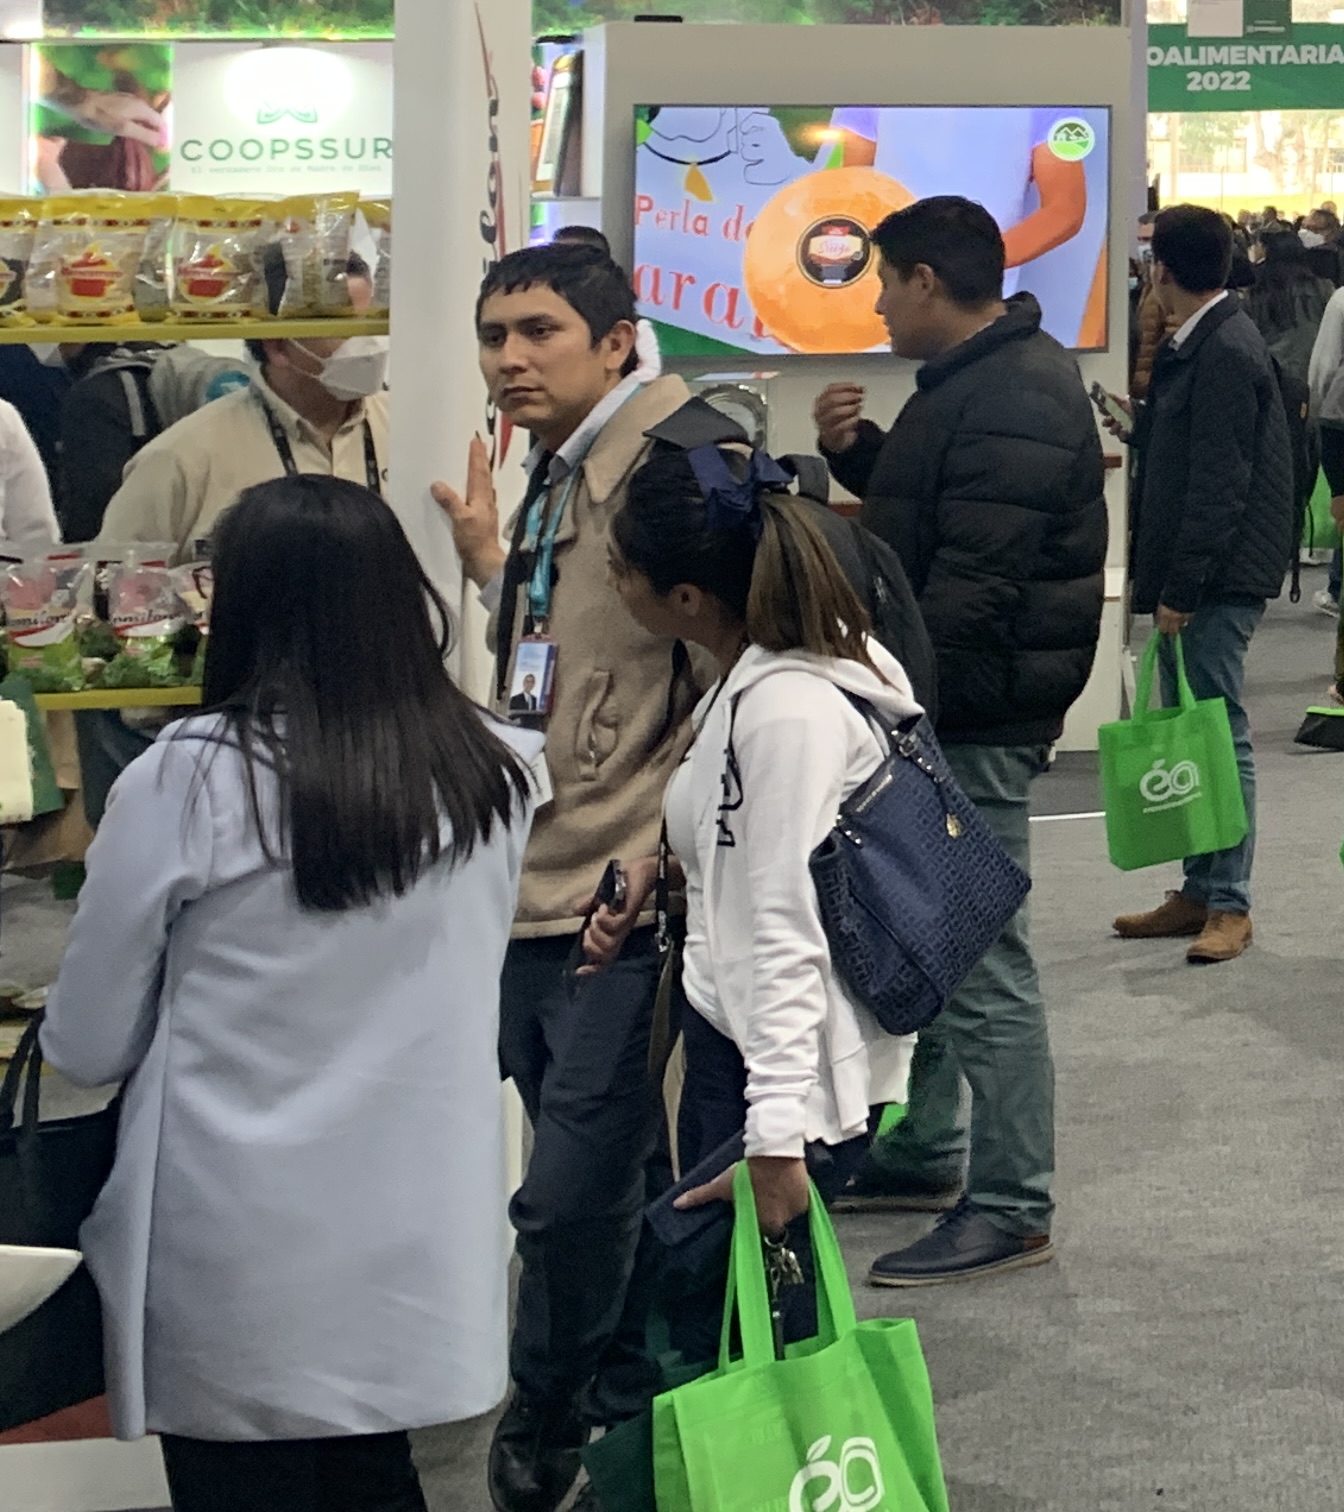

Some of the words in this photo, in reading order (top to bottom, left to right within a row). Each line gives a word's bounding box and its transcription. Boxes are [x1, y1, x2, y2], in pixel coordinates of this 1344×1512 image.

[1187, 70, 1251, 91] 2022
[180, 137, 393, 161] COOPSSUR
[634, 194, 709, 236] Perla
